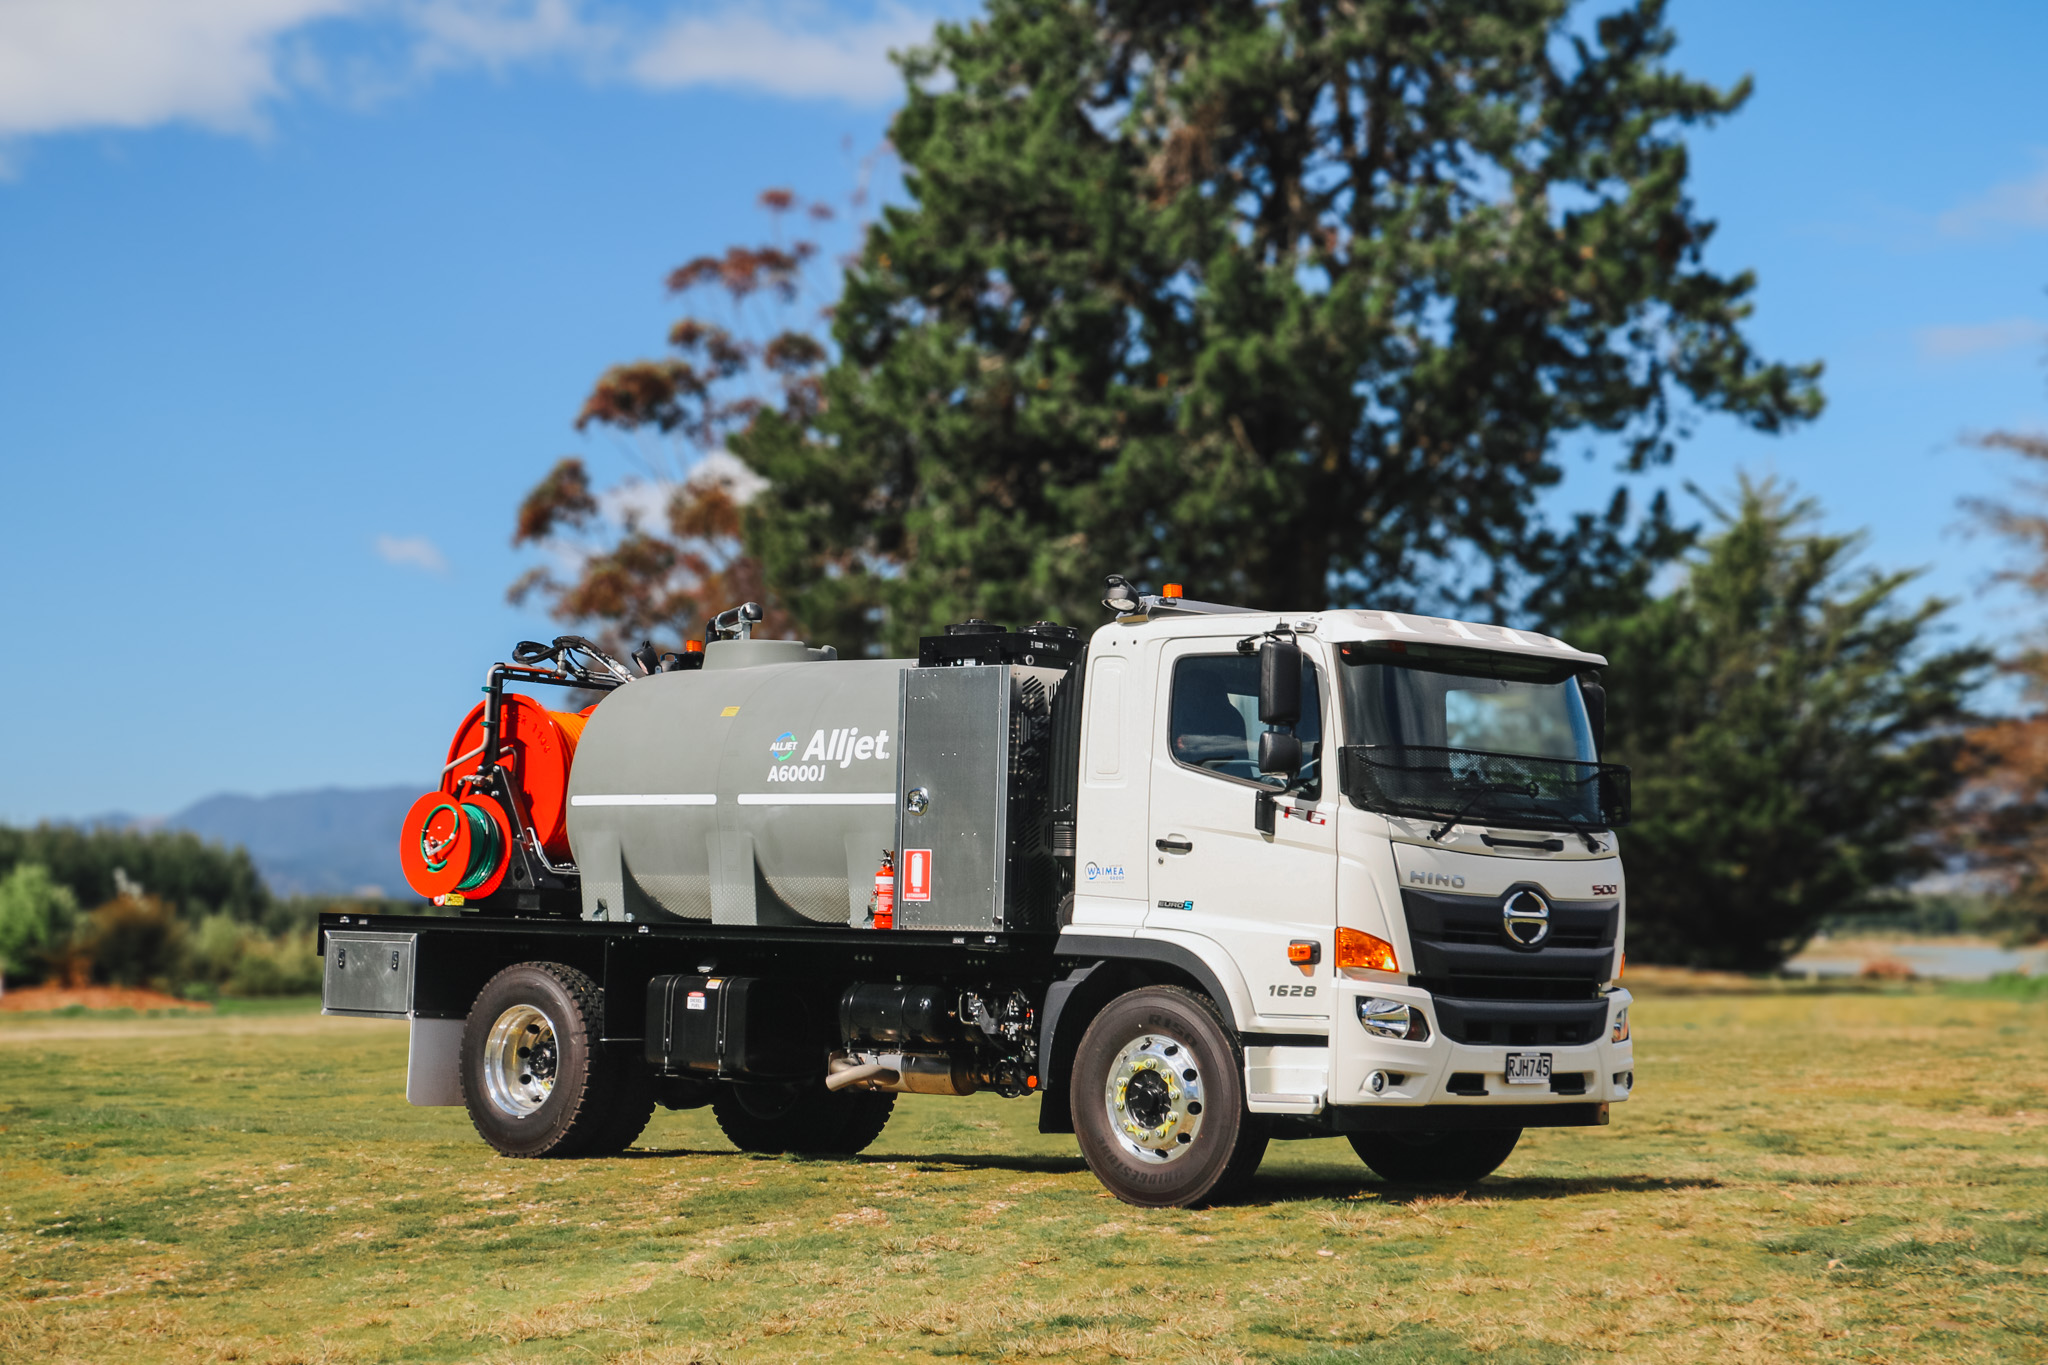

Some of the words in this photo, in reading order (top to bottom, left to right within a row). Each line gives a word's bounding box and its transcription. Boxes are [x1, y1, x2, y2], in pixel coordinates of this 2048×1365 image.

[769, 741, 798, 752] ALLJET
[766, 764, 826, 782] A6000J
[1087, 867, 1124, 875] WAIMEA
[1410, 870, 1465, 889] HINO
[1592, 884, 1617, 896] 500
[1269, 985, 1317, 997] 1628
[1508, 1059, 1549, 1077] RJH745
